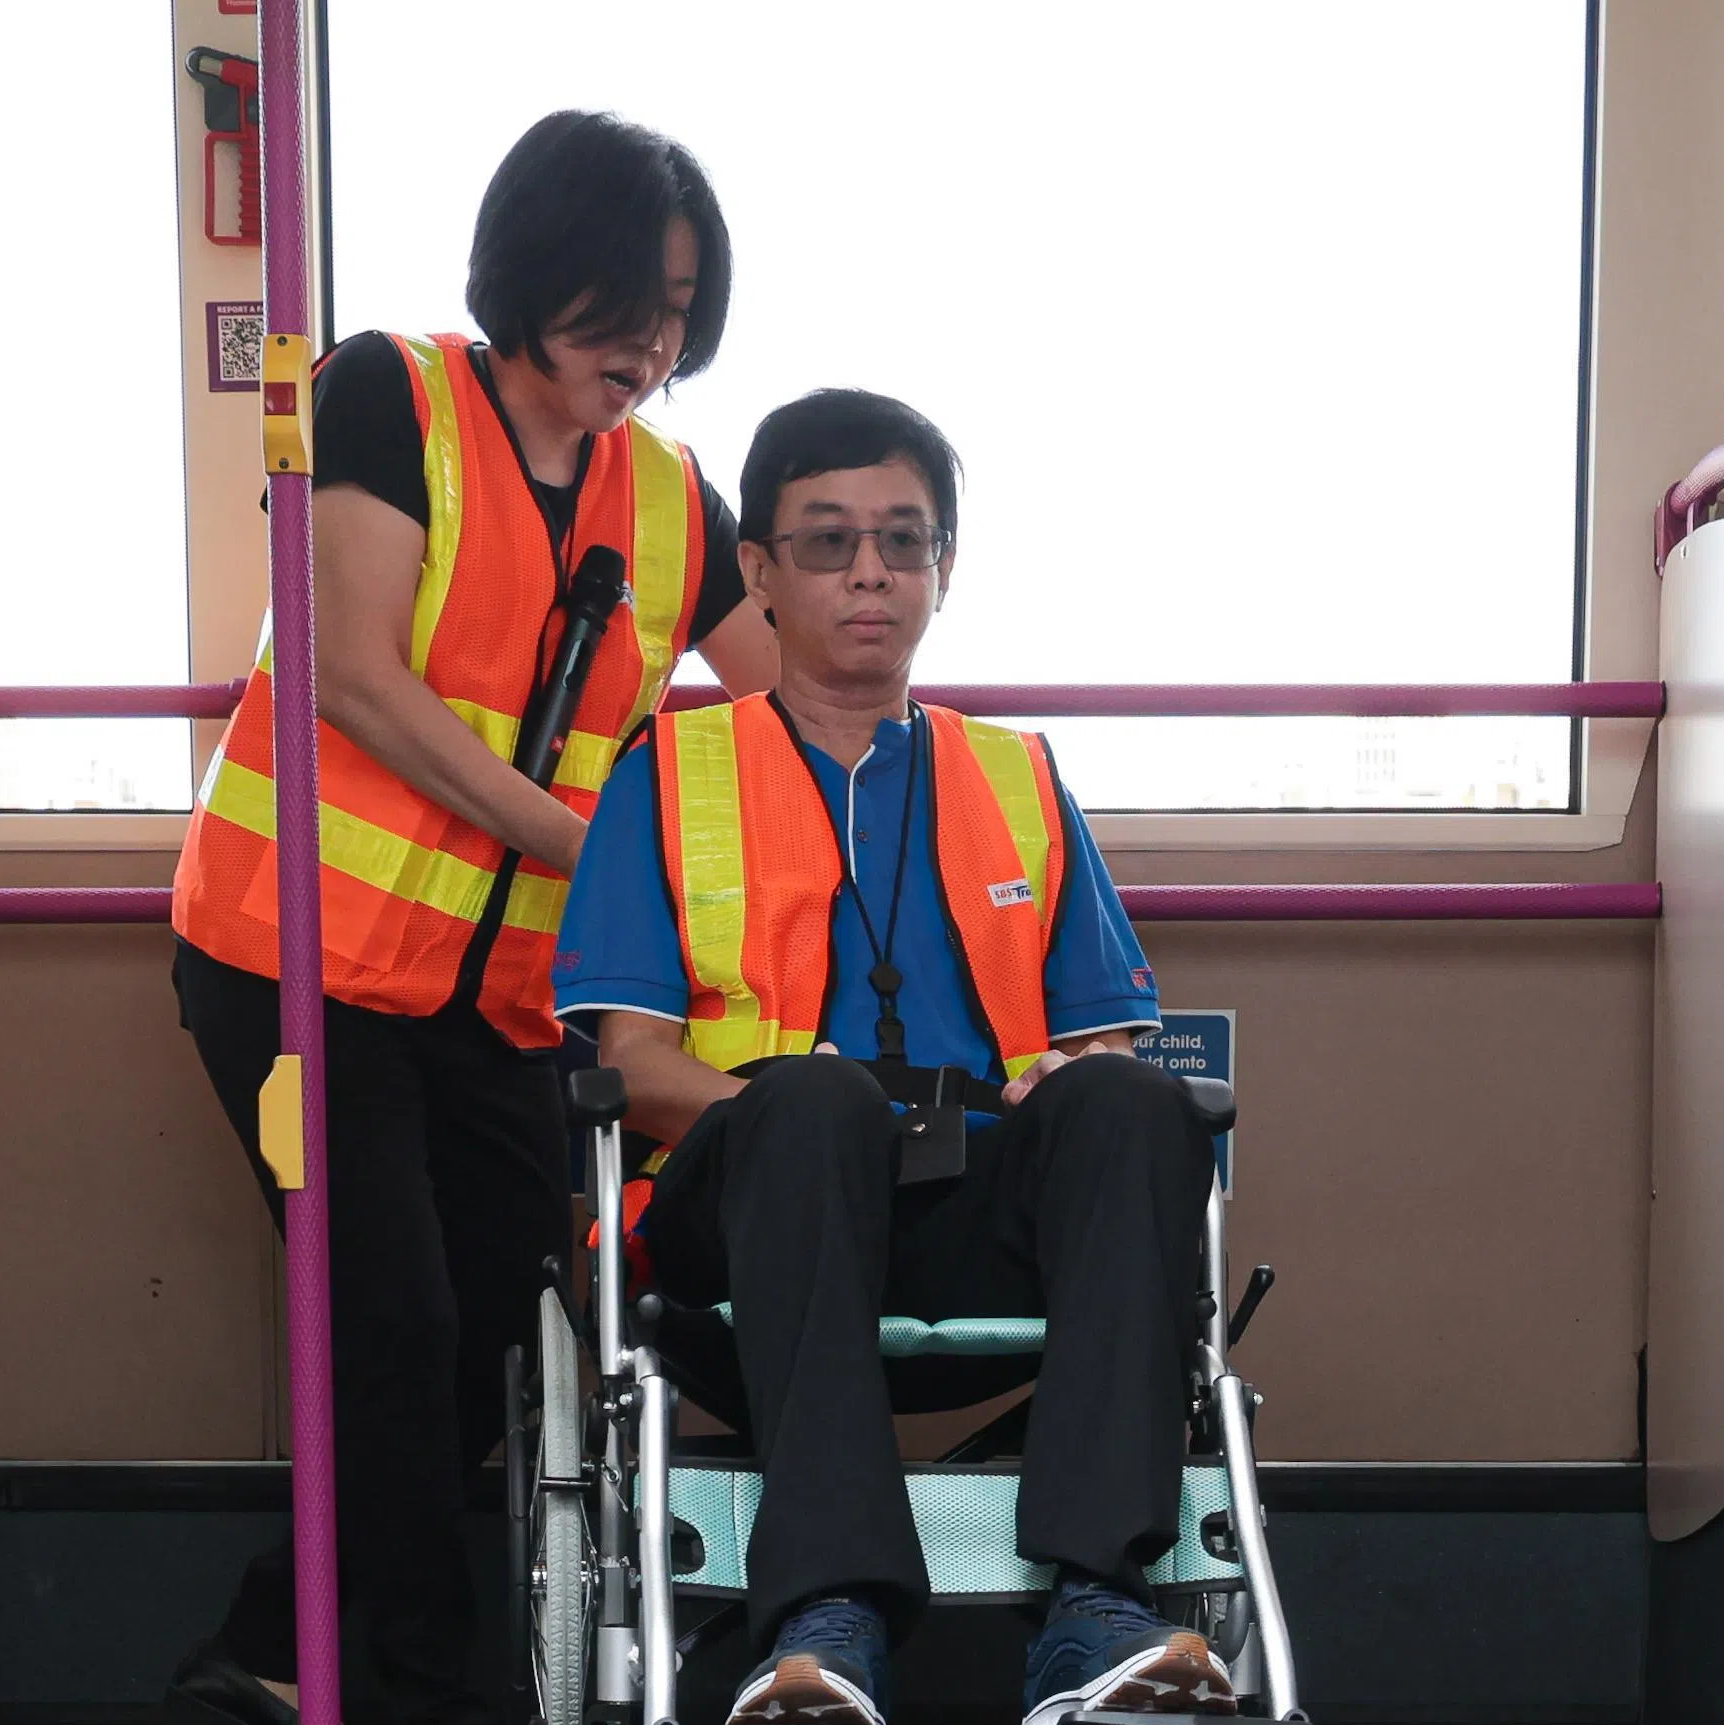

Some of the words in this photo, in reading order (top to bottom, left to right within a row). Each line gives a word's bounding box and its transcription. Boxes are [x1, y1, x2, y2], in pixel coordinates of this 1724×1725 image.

[217, 305, 248, 314] REPORT
[1159, 1034, 1206, 1051] child,
[1169, 1055, 1207, 1070] onto
